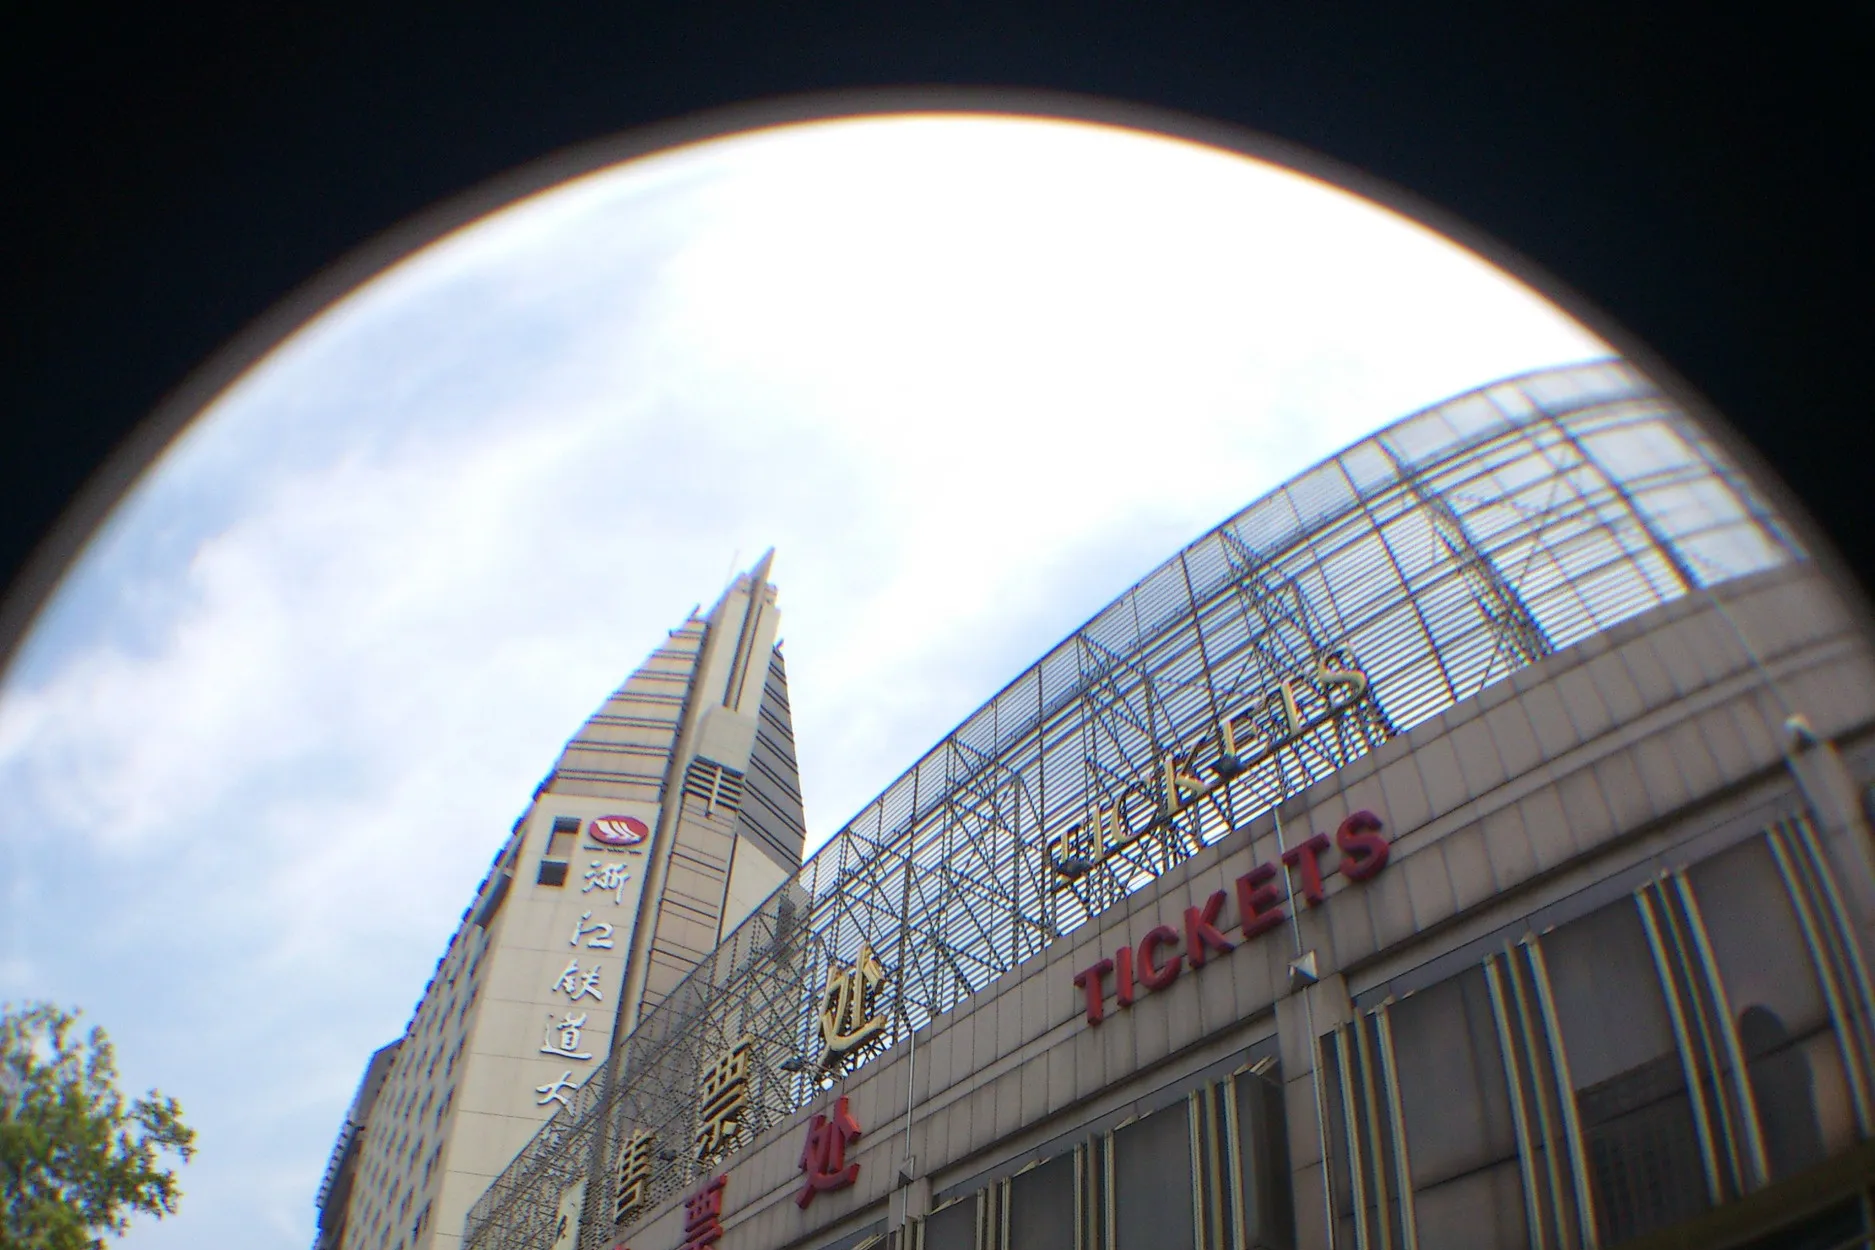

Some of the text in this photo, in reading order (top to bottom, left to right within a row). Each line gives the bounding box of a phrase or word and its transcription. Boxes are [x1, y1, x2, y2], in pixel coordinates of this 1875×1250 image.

[1073, 810, 1391, 1027] TICKETS
[614, 942, 887, 1225] 售票处
